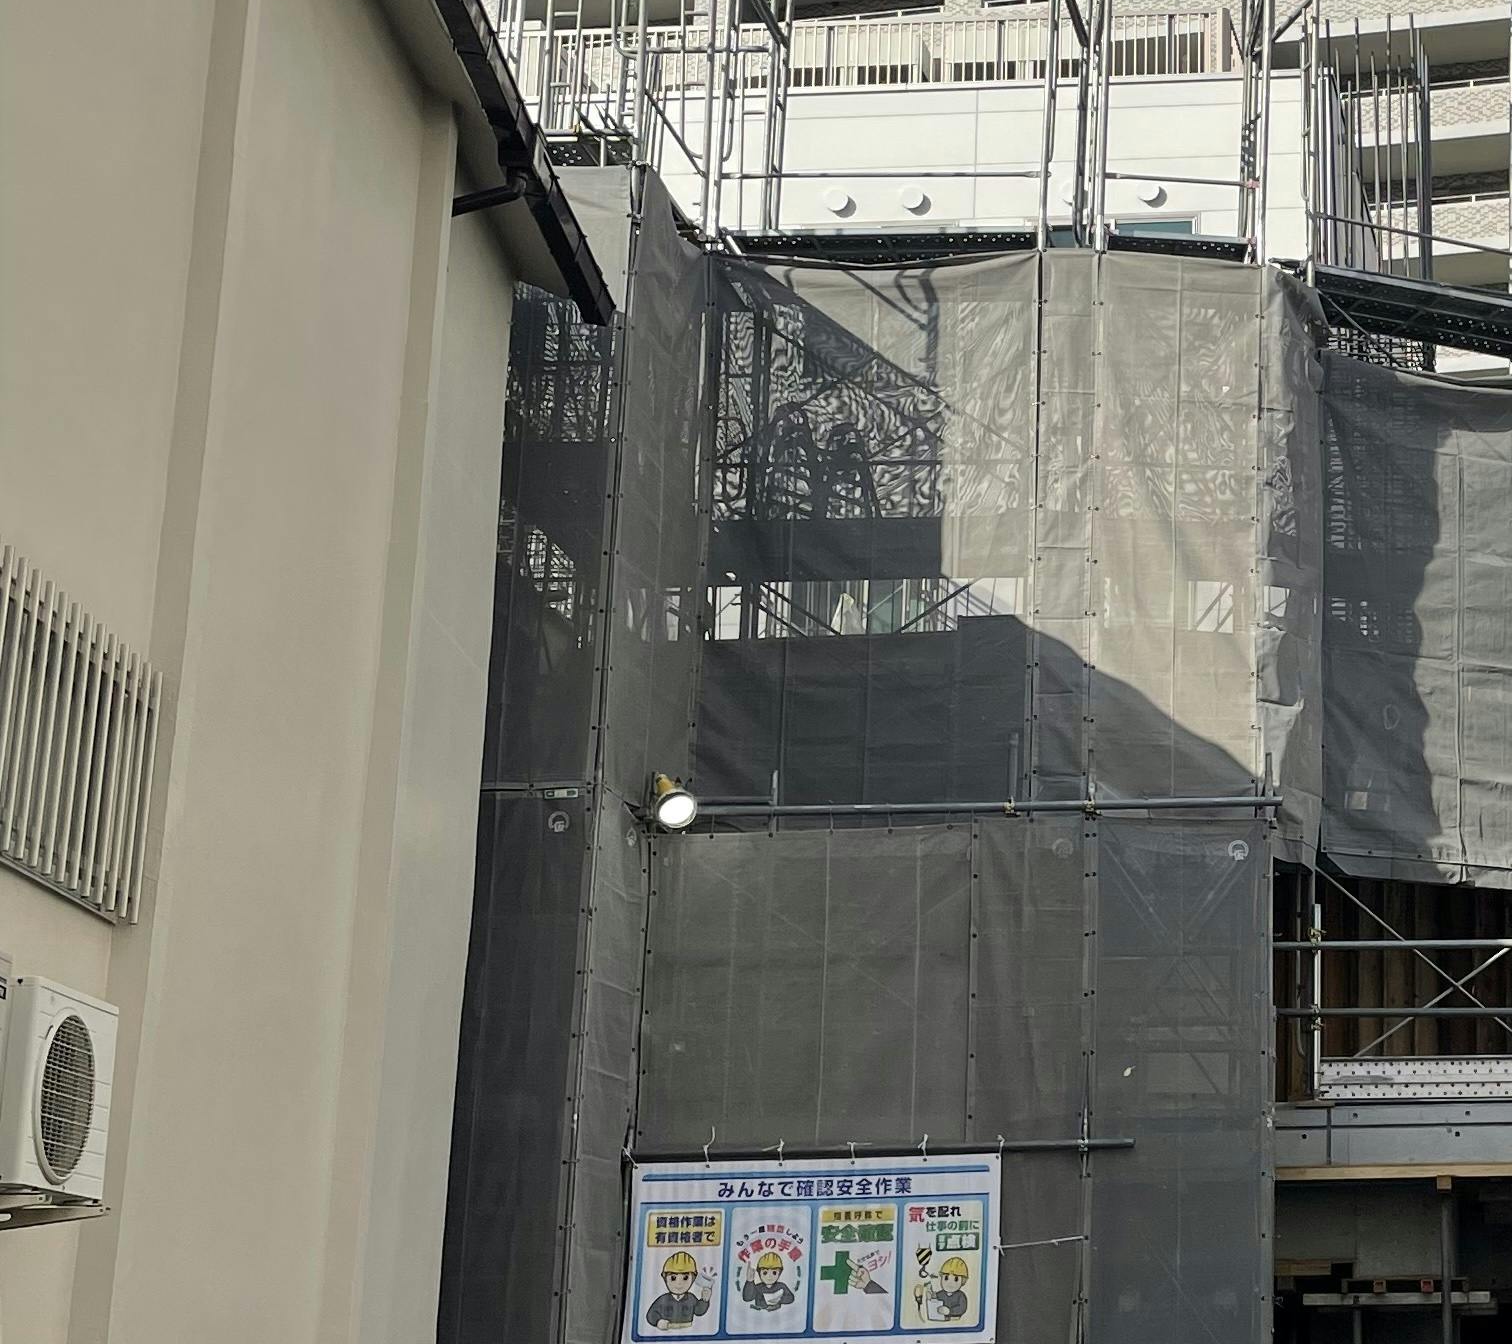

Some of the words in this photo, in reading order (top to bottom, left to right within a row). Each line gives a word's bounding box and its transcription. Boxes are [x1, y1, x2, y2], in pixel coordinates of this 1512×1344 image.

[717, 1176, 913, 1198] みんなで確認安全作業
